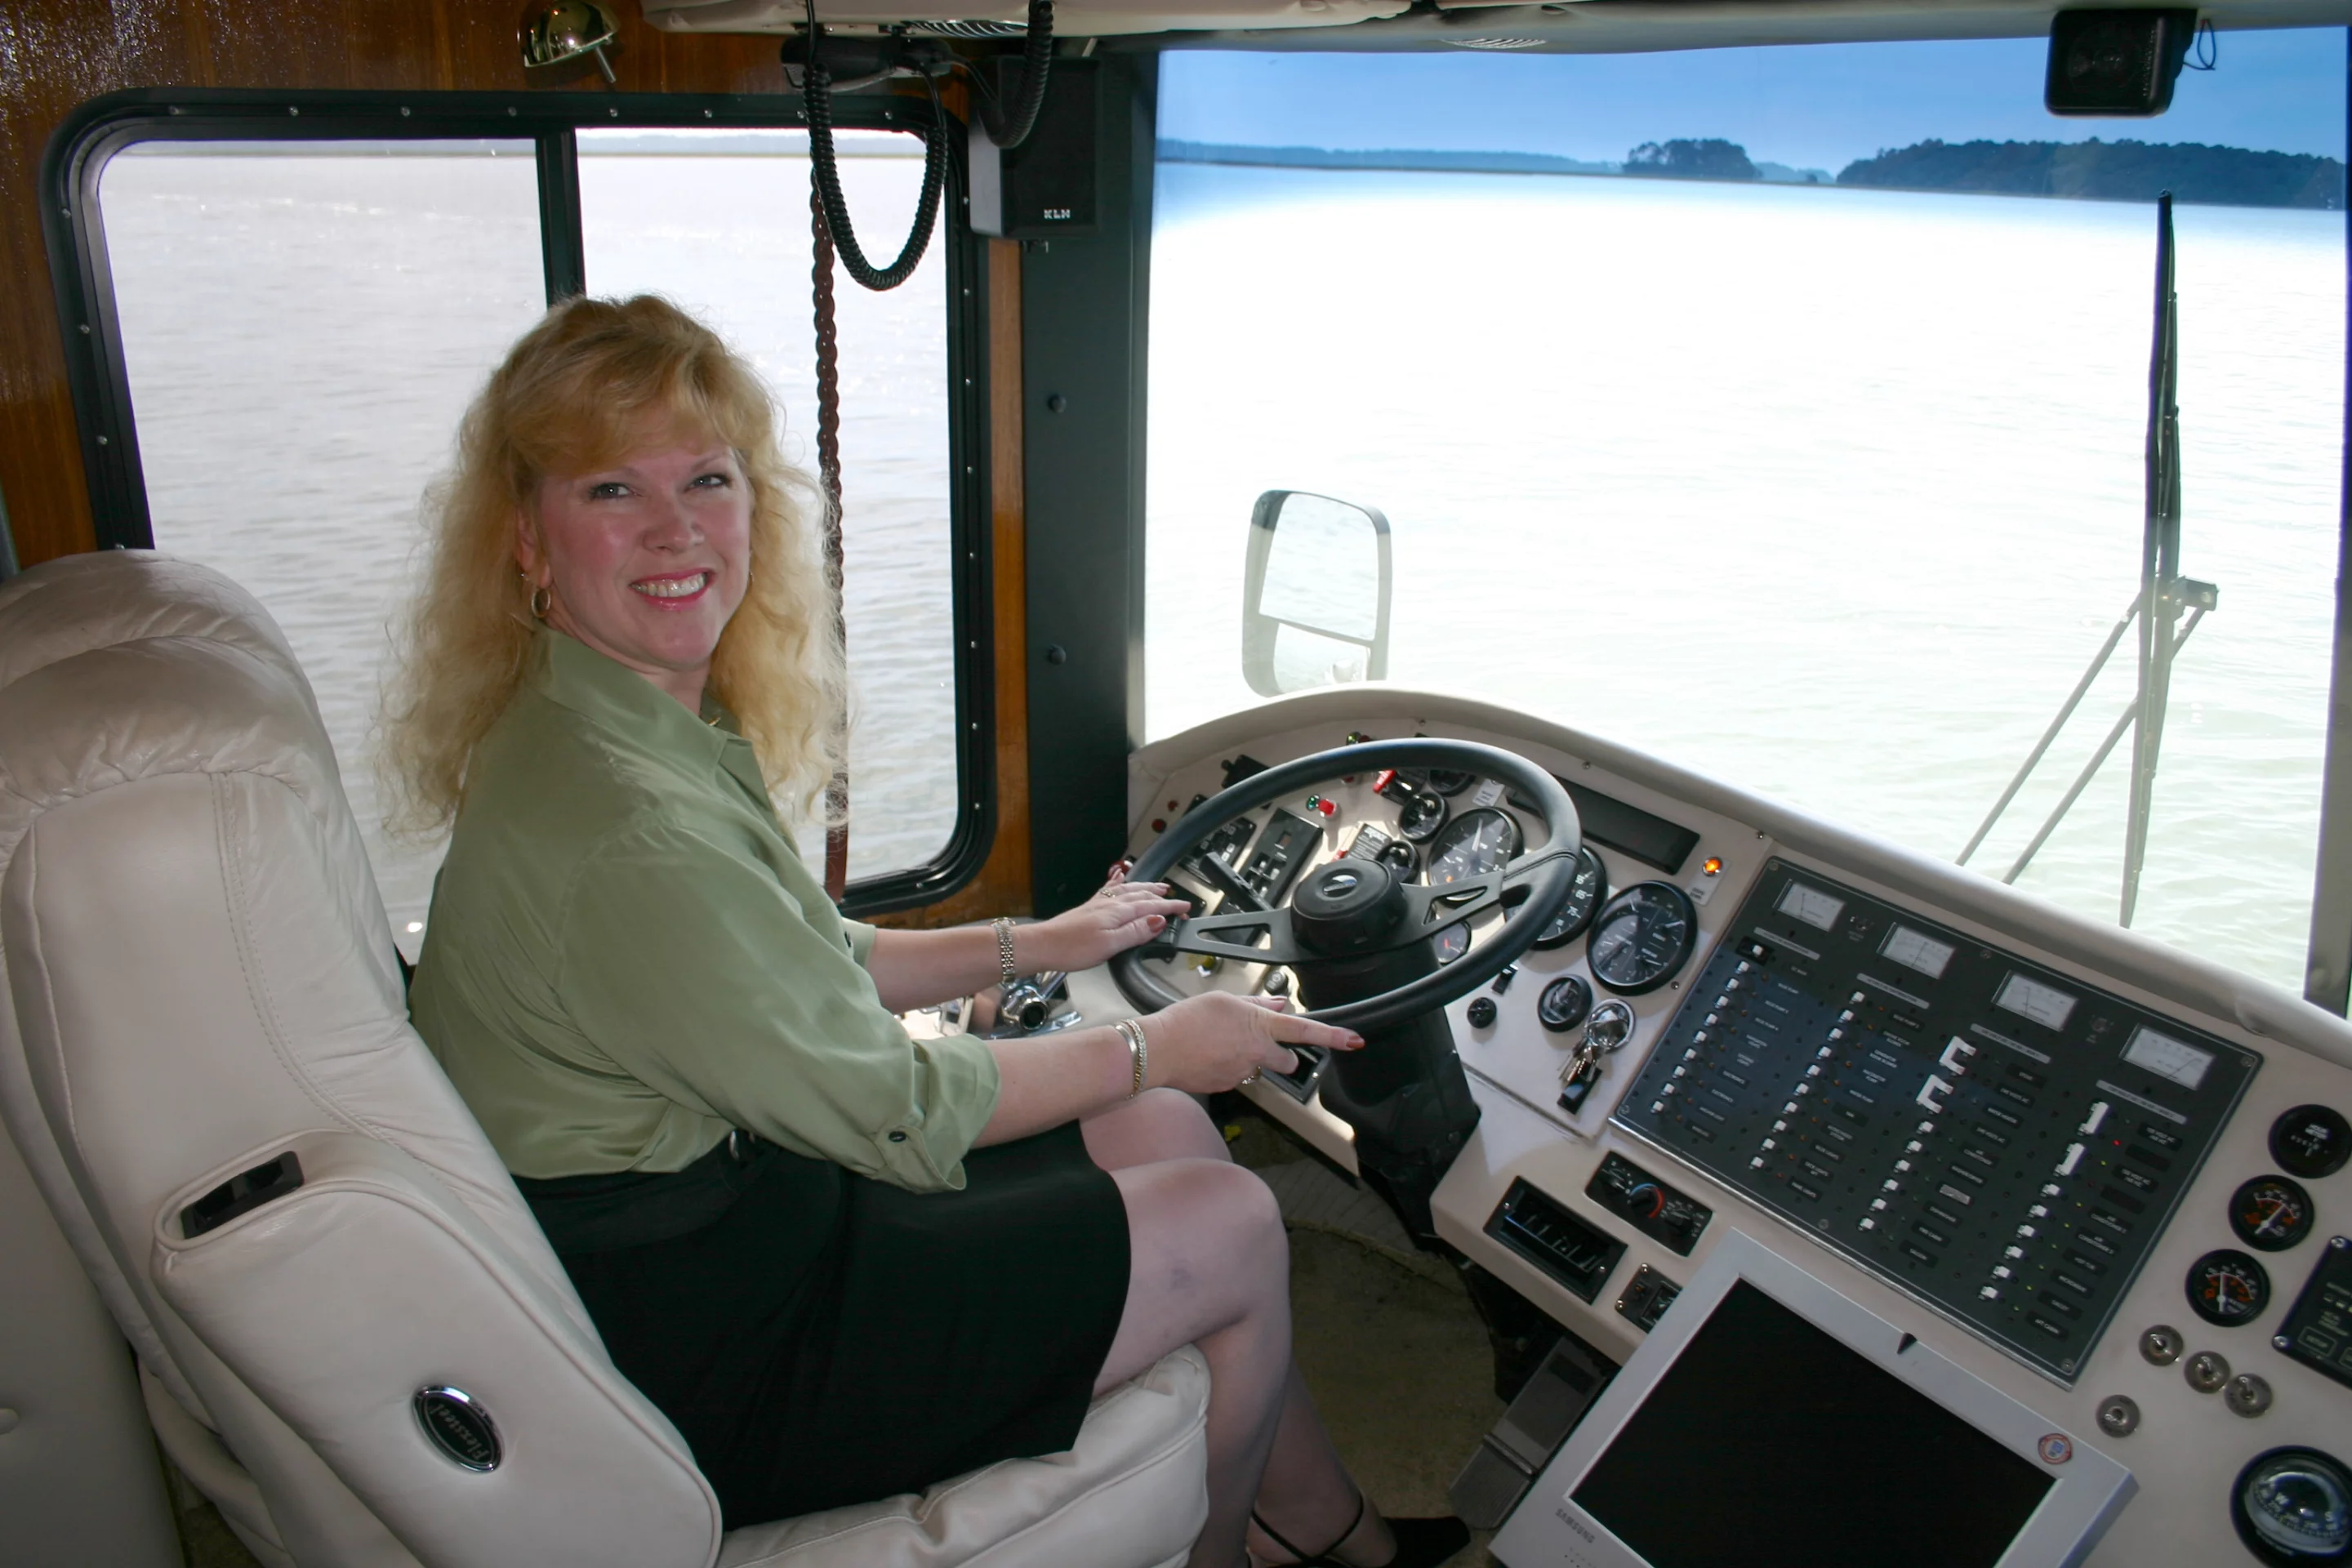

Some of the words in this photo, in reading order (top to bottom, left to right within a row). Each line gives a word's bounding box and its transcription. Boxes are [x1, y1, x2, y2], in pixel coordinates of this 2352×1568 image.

[1575, 889, 1587, 900] 65
[1566, 906, 1579, 916] 75
[1555, 1508, 1596, 1544] SAMSUNG
